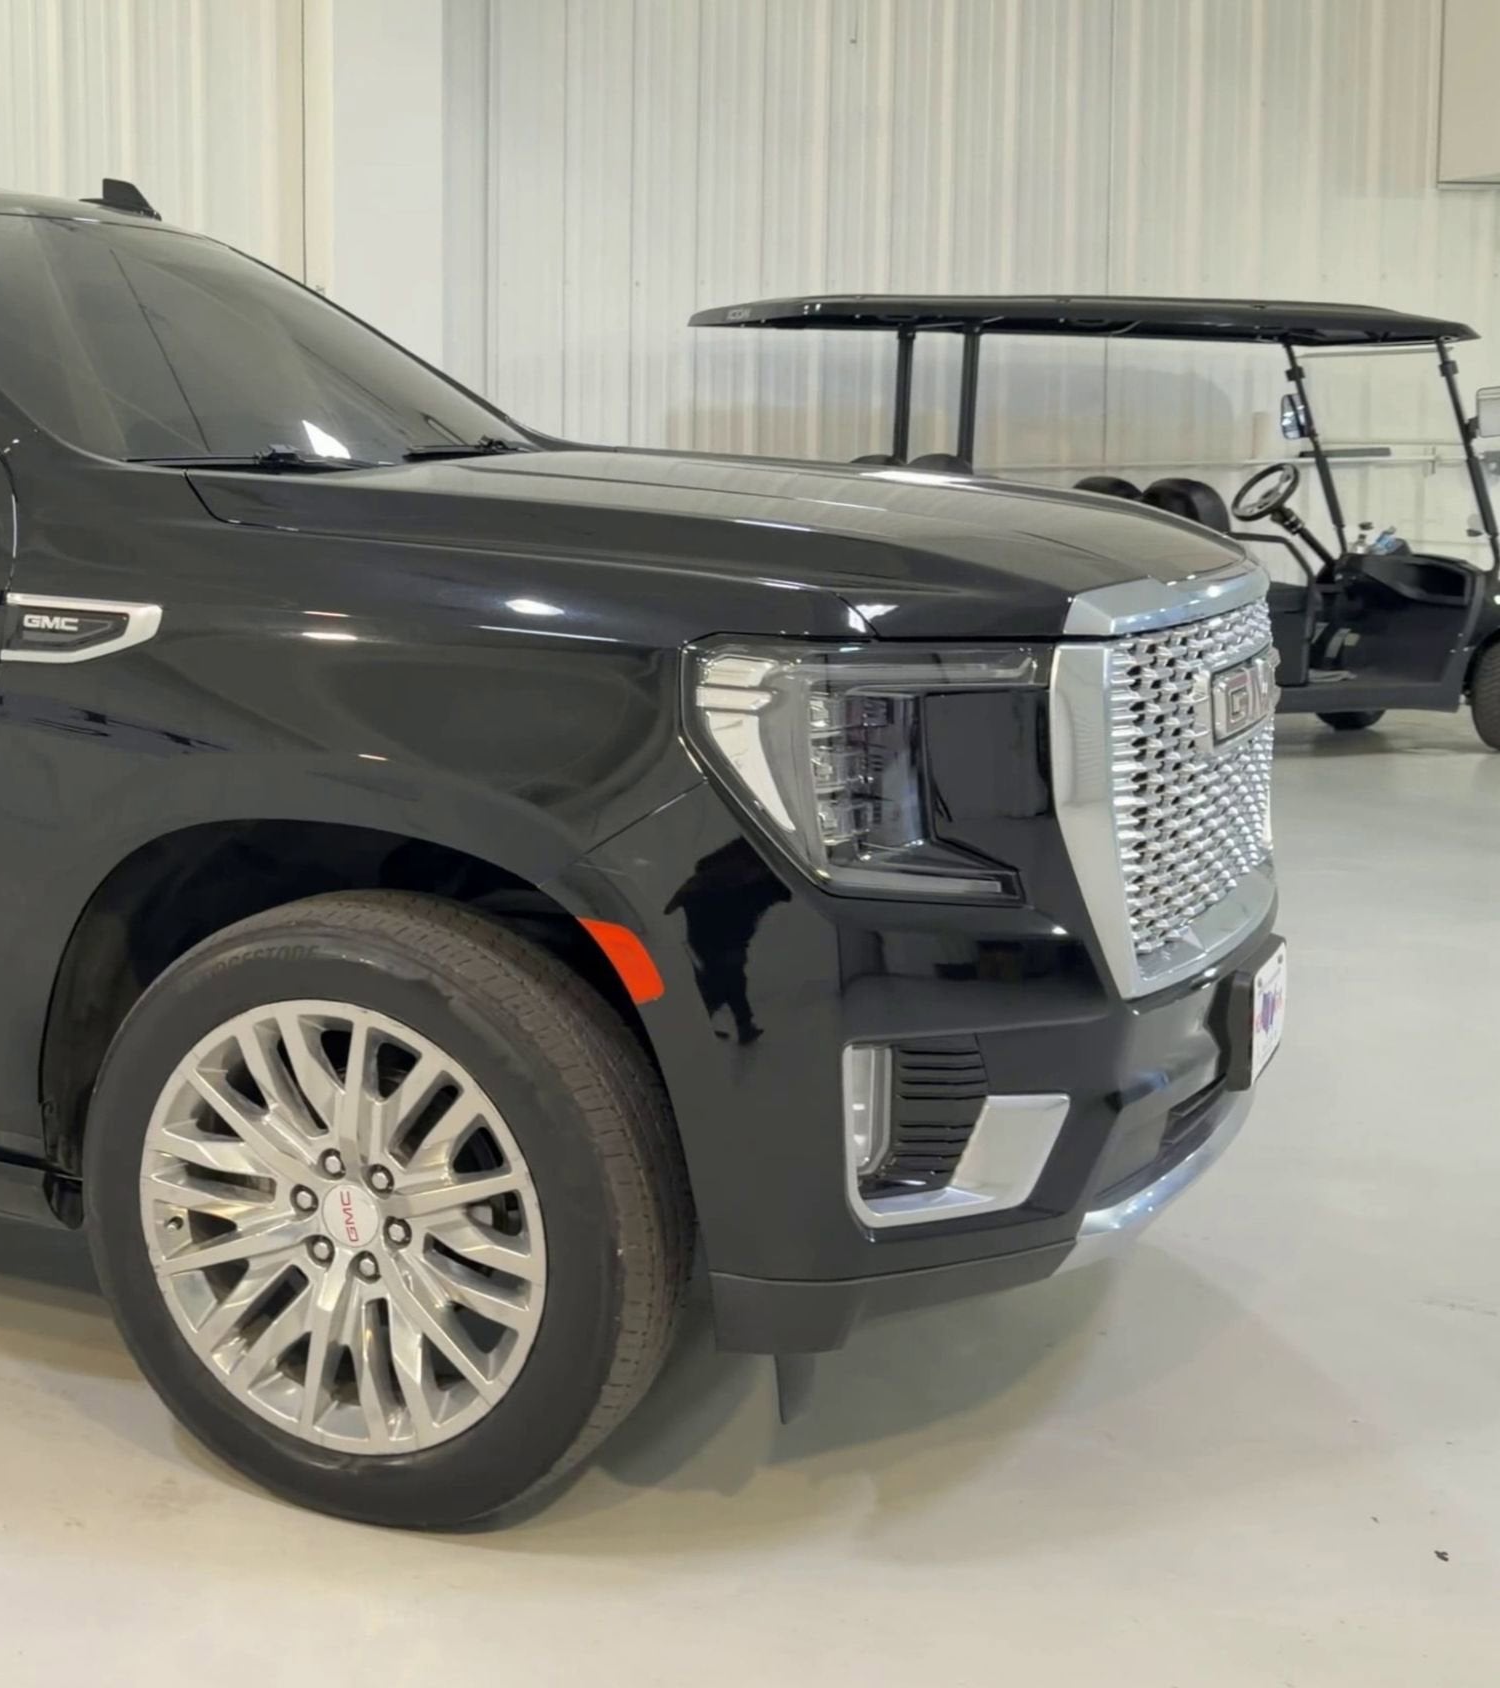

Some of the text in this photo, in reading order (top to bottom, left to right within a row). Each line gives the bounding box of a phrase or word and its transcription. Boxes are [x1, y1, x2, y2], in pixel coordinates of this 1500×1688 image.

[23, 614, 79, 631] GMC
[1213, 657, 1272, 738] GM
[340, 1190, 359, 1242] GMC
